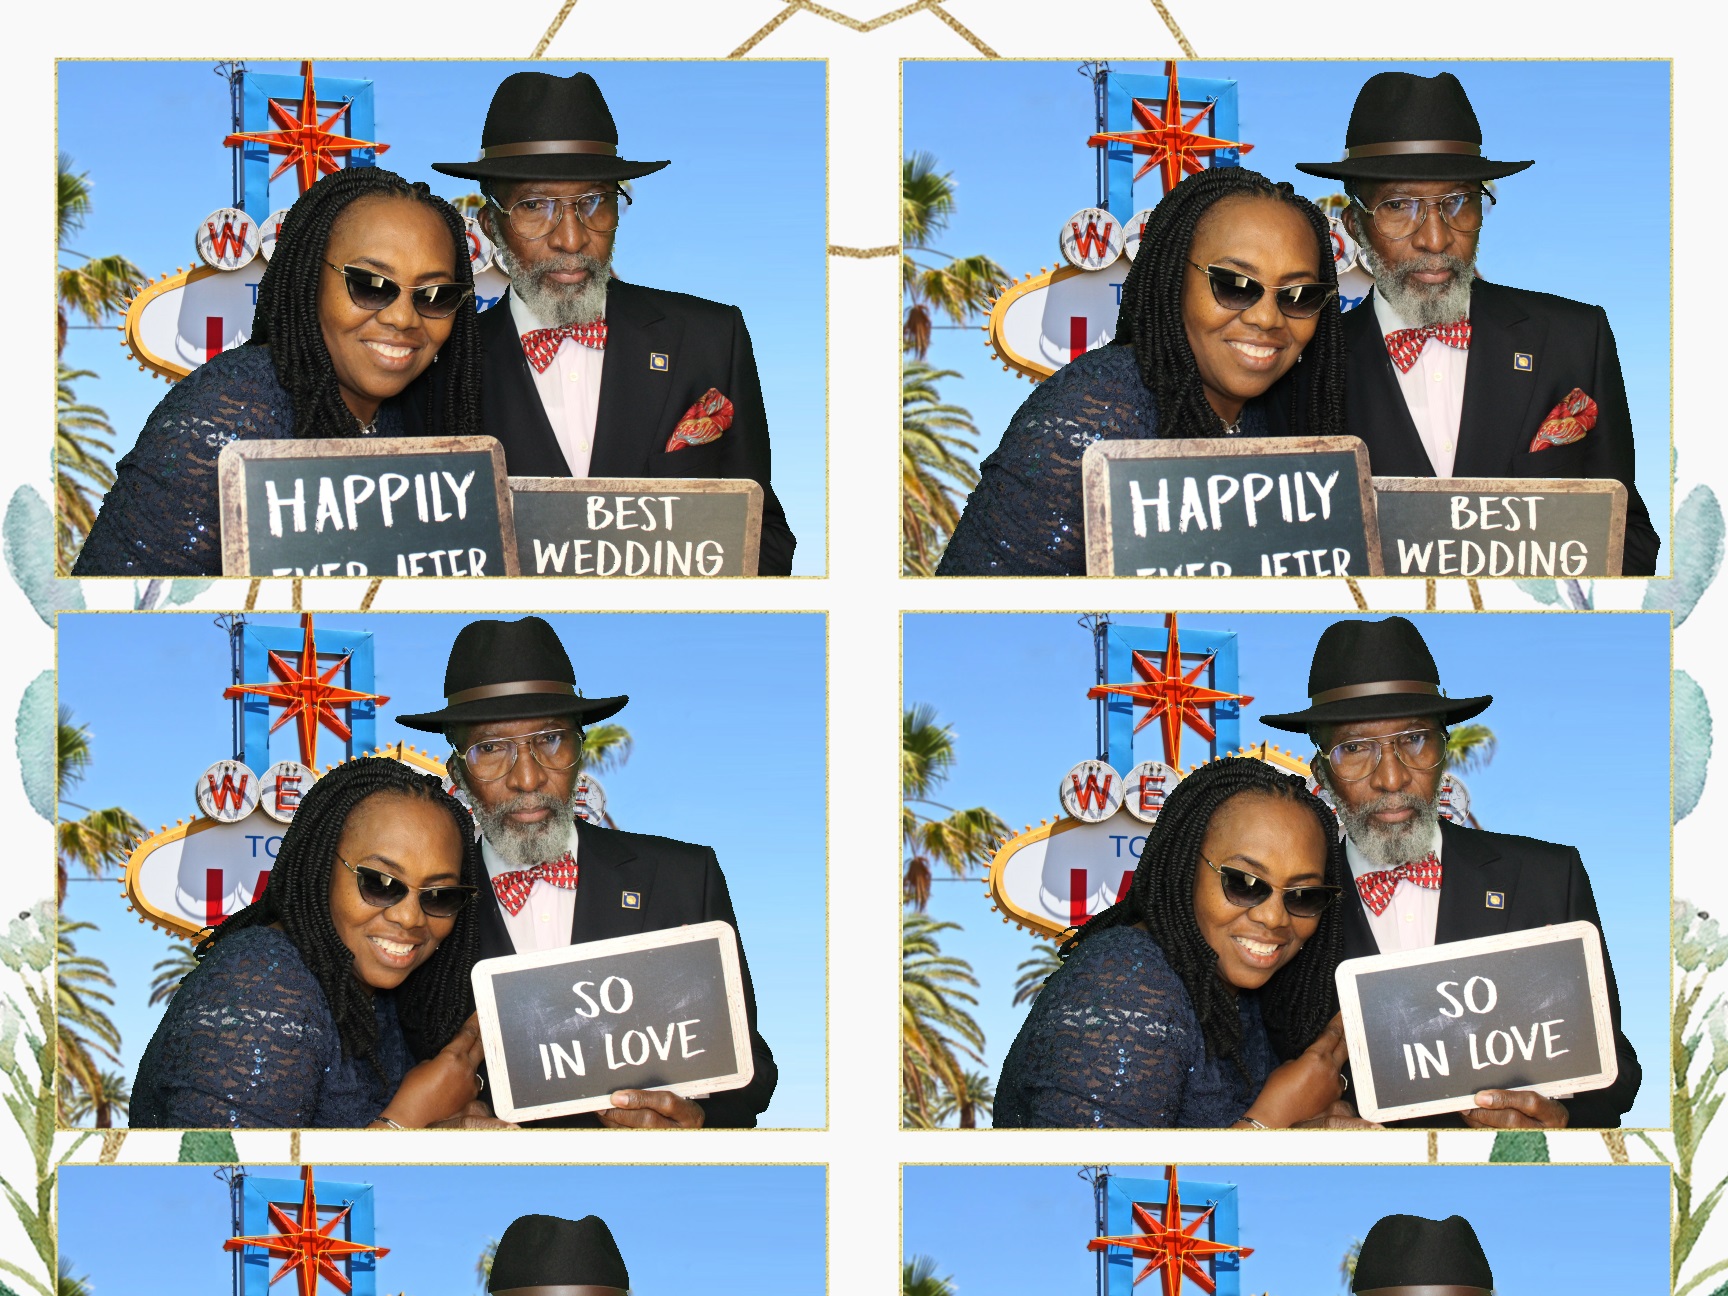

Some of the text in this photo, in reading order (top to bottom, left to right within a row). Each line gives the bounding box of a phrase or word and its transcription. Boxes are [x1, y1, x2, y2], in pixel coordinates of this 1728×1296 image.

[265, 470, 475, 538] HAPPILY
[587, 495, 681, 531] BEST
[1129, 470, 1339, 538] HAPPILY
[1451, 495, 1545, 531] BEST
[533, 540, 724, 576] WEDDING
[1397, 540, 1588, 576] WEDDING
[572, 975, 634, 1018] SO
[1436, 975, 1498, 1018] SO
[538, 1019, 706, 1081] IN LOVE
[1402, 1019, 1570, 1081] IN LOVE
